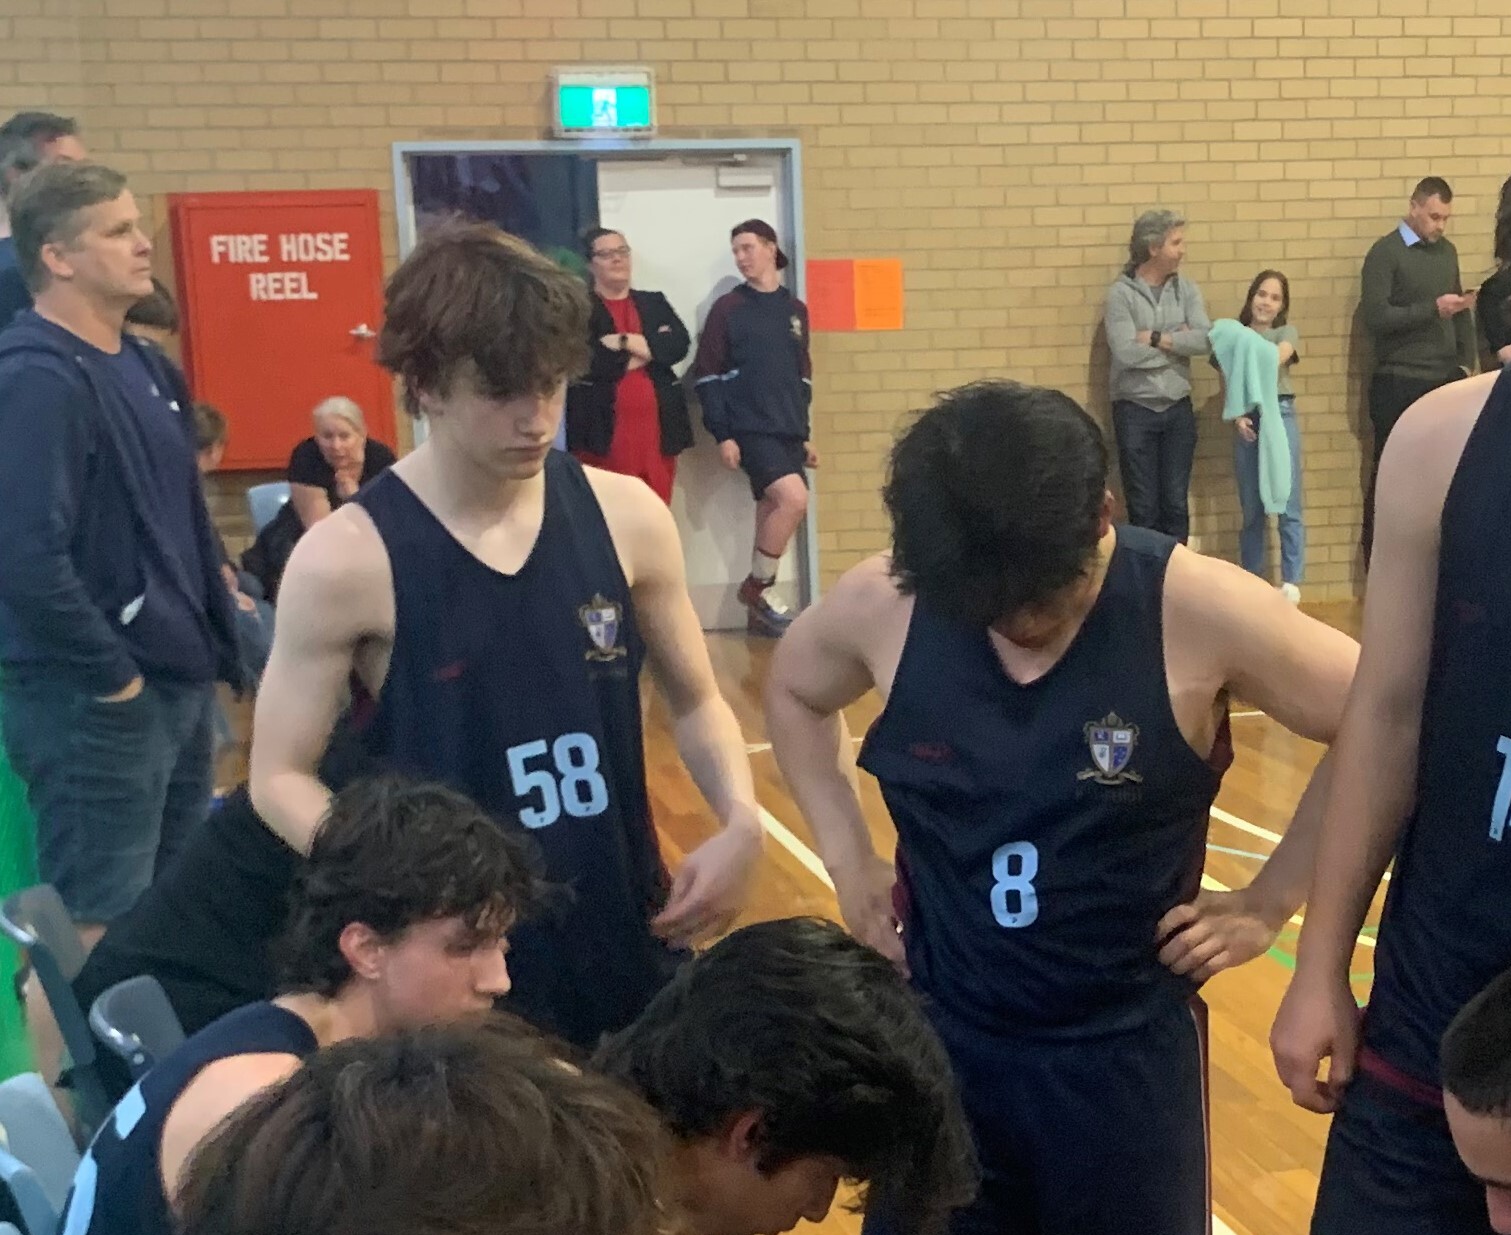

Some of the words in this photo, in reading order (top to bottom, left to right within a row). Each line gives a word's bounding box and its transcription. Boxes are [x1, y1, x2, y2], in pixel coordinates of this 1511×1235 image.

[209, 234, 270, 264] FIRE
[279, 232, 351, 262] HOSE
[249, 271, 319, 301] REEL
[506, 732, 609, 829] 58
[989, 841, 1039, 928] 8
